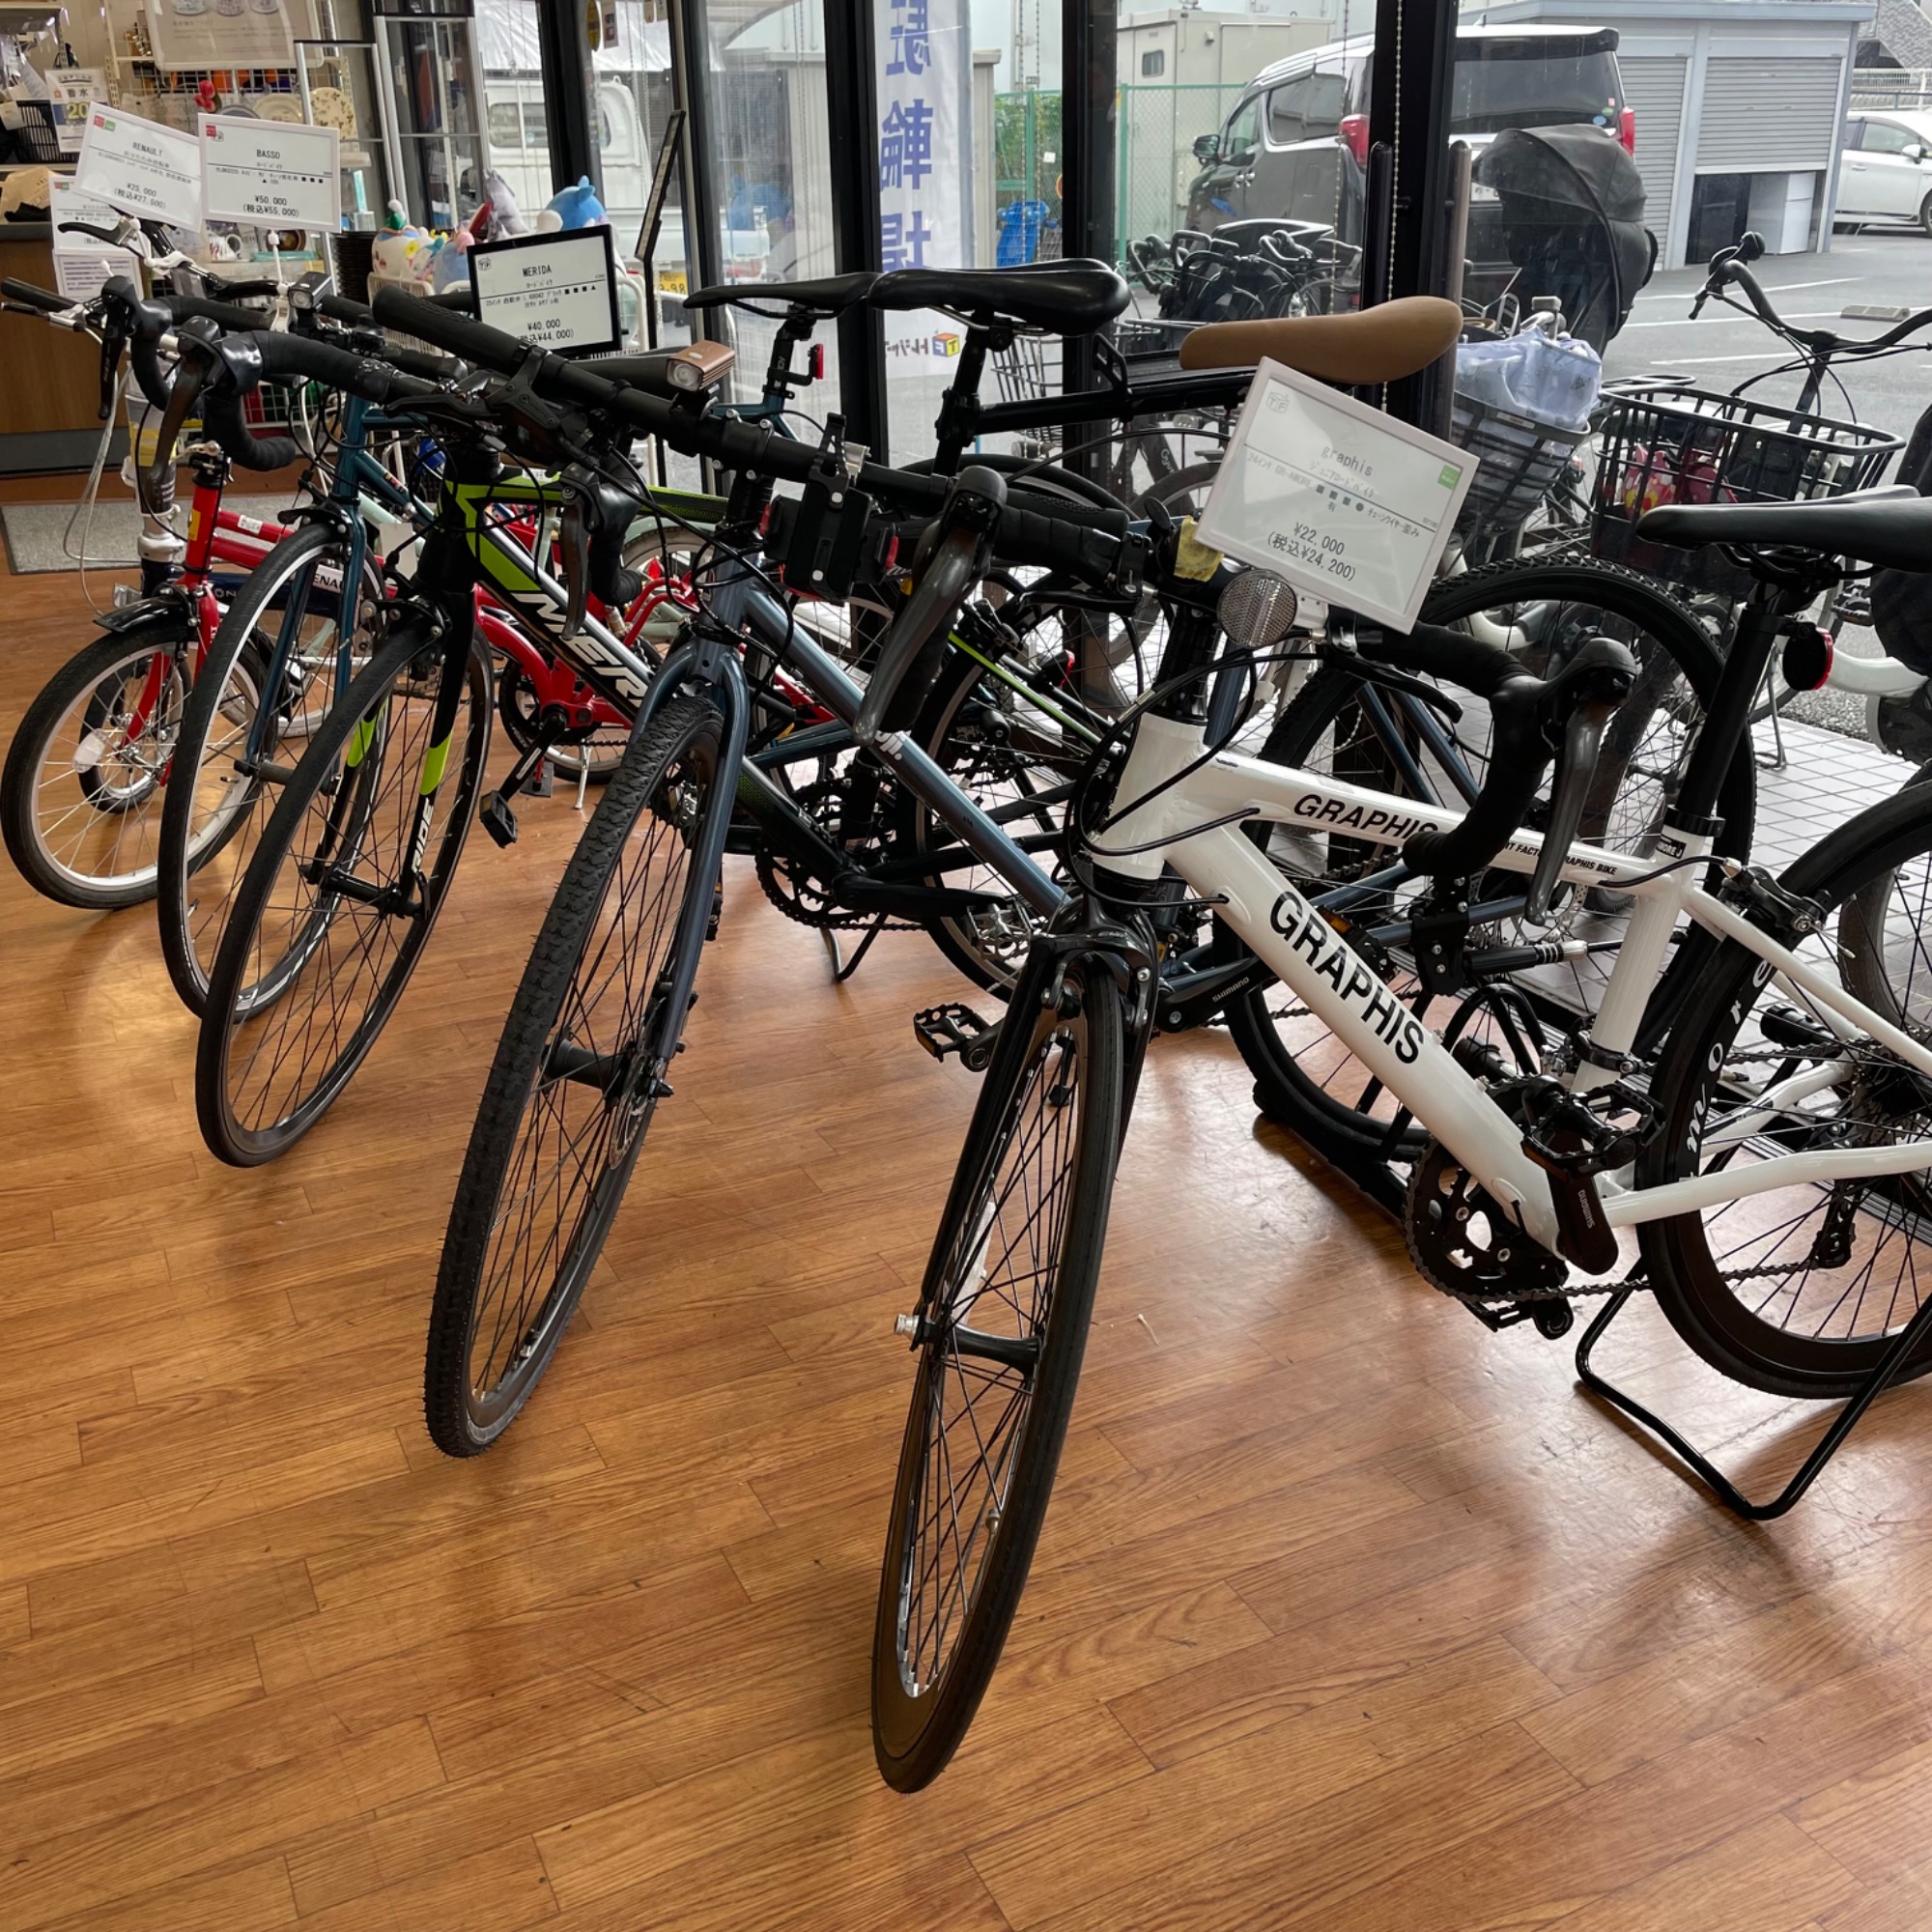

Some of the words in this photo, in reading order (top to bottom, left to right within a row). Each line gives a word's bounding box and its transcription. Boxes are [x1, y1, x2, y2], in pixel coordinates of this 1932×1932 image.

[256, 149, 281, 159] BASSO
[523, 265, 552, 277] MERIDA
[1321, 445, 1374, 477] graphis
[1293, 522, 1345, 554] ¥22,000
[1267, 531, 1356, 582] (税込¥24,200)
[1596, 864, 1618, 875] BIKE
[1269, 891, 1425, 1064] GRAPHIS
